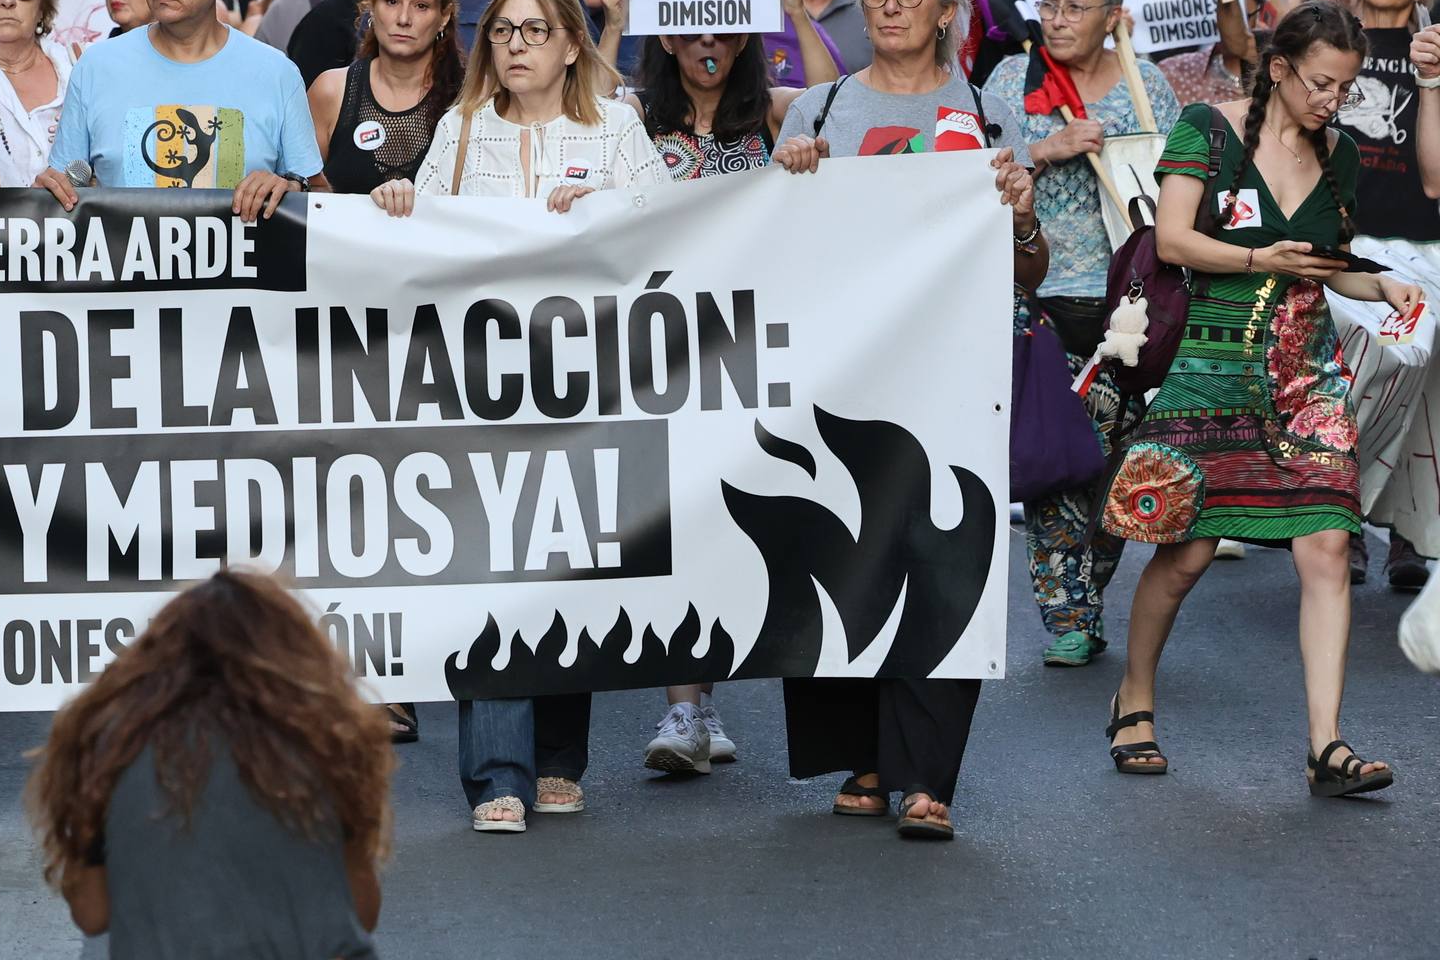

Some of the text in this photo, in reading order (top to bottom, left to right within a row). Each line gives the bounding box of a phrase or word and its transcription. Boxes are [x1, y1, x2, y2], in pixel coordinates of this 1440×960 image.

[120, 216, 259, 281] ARDE
[20, 308, 139, 432] DE
[160, 305, 279, 428] LA
[294, 270, 791, 425] INACCIÓN:
[3, 462, 66, 585] Y
[85, 450, 455, 583] MEDIOS
[467, 447, 623, 573] YA!
